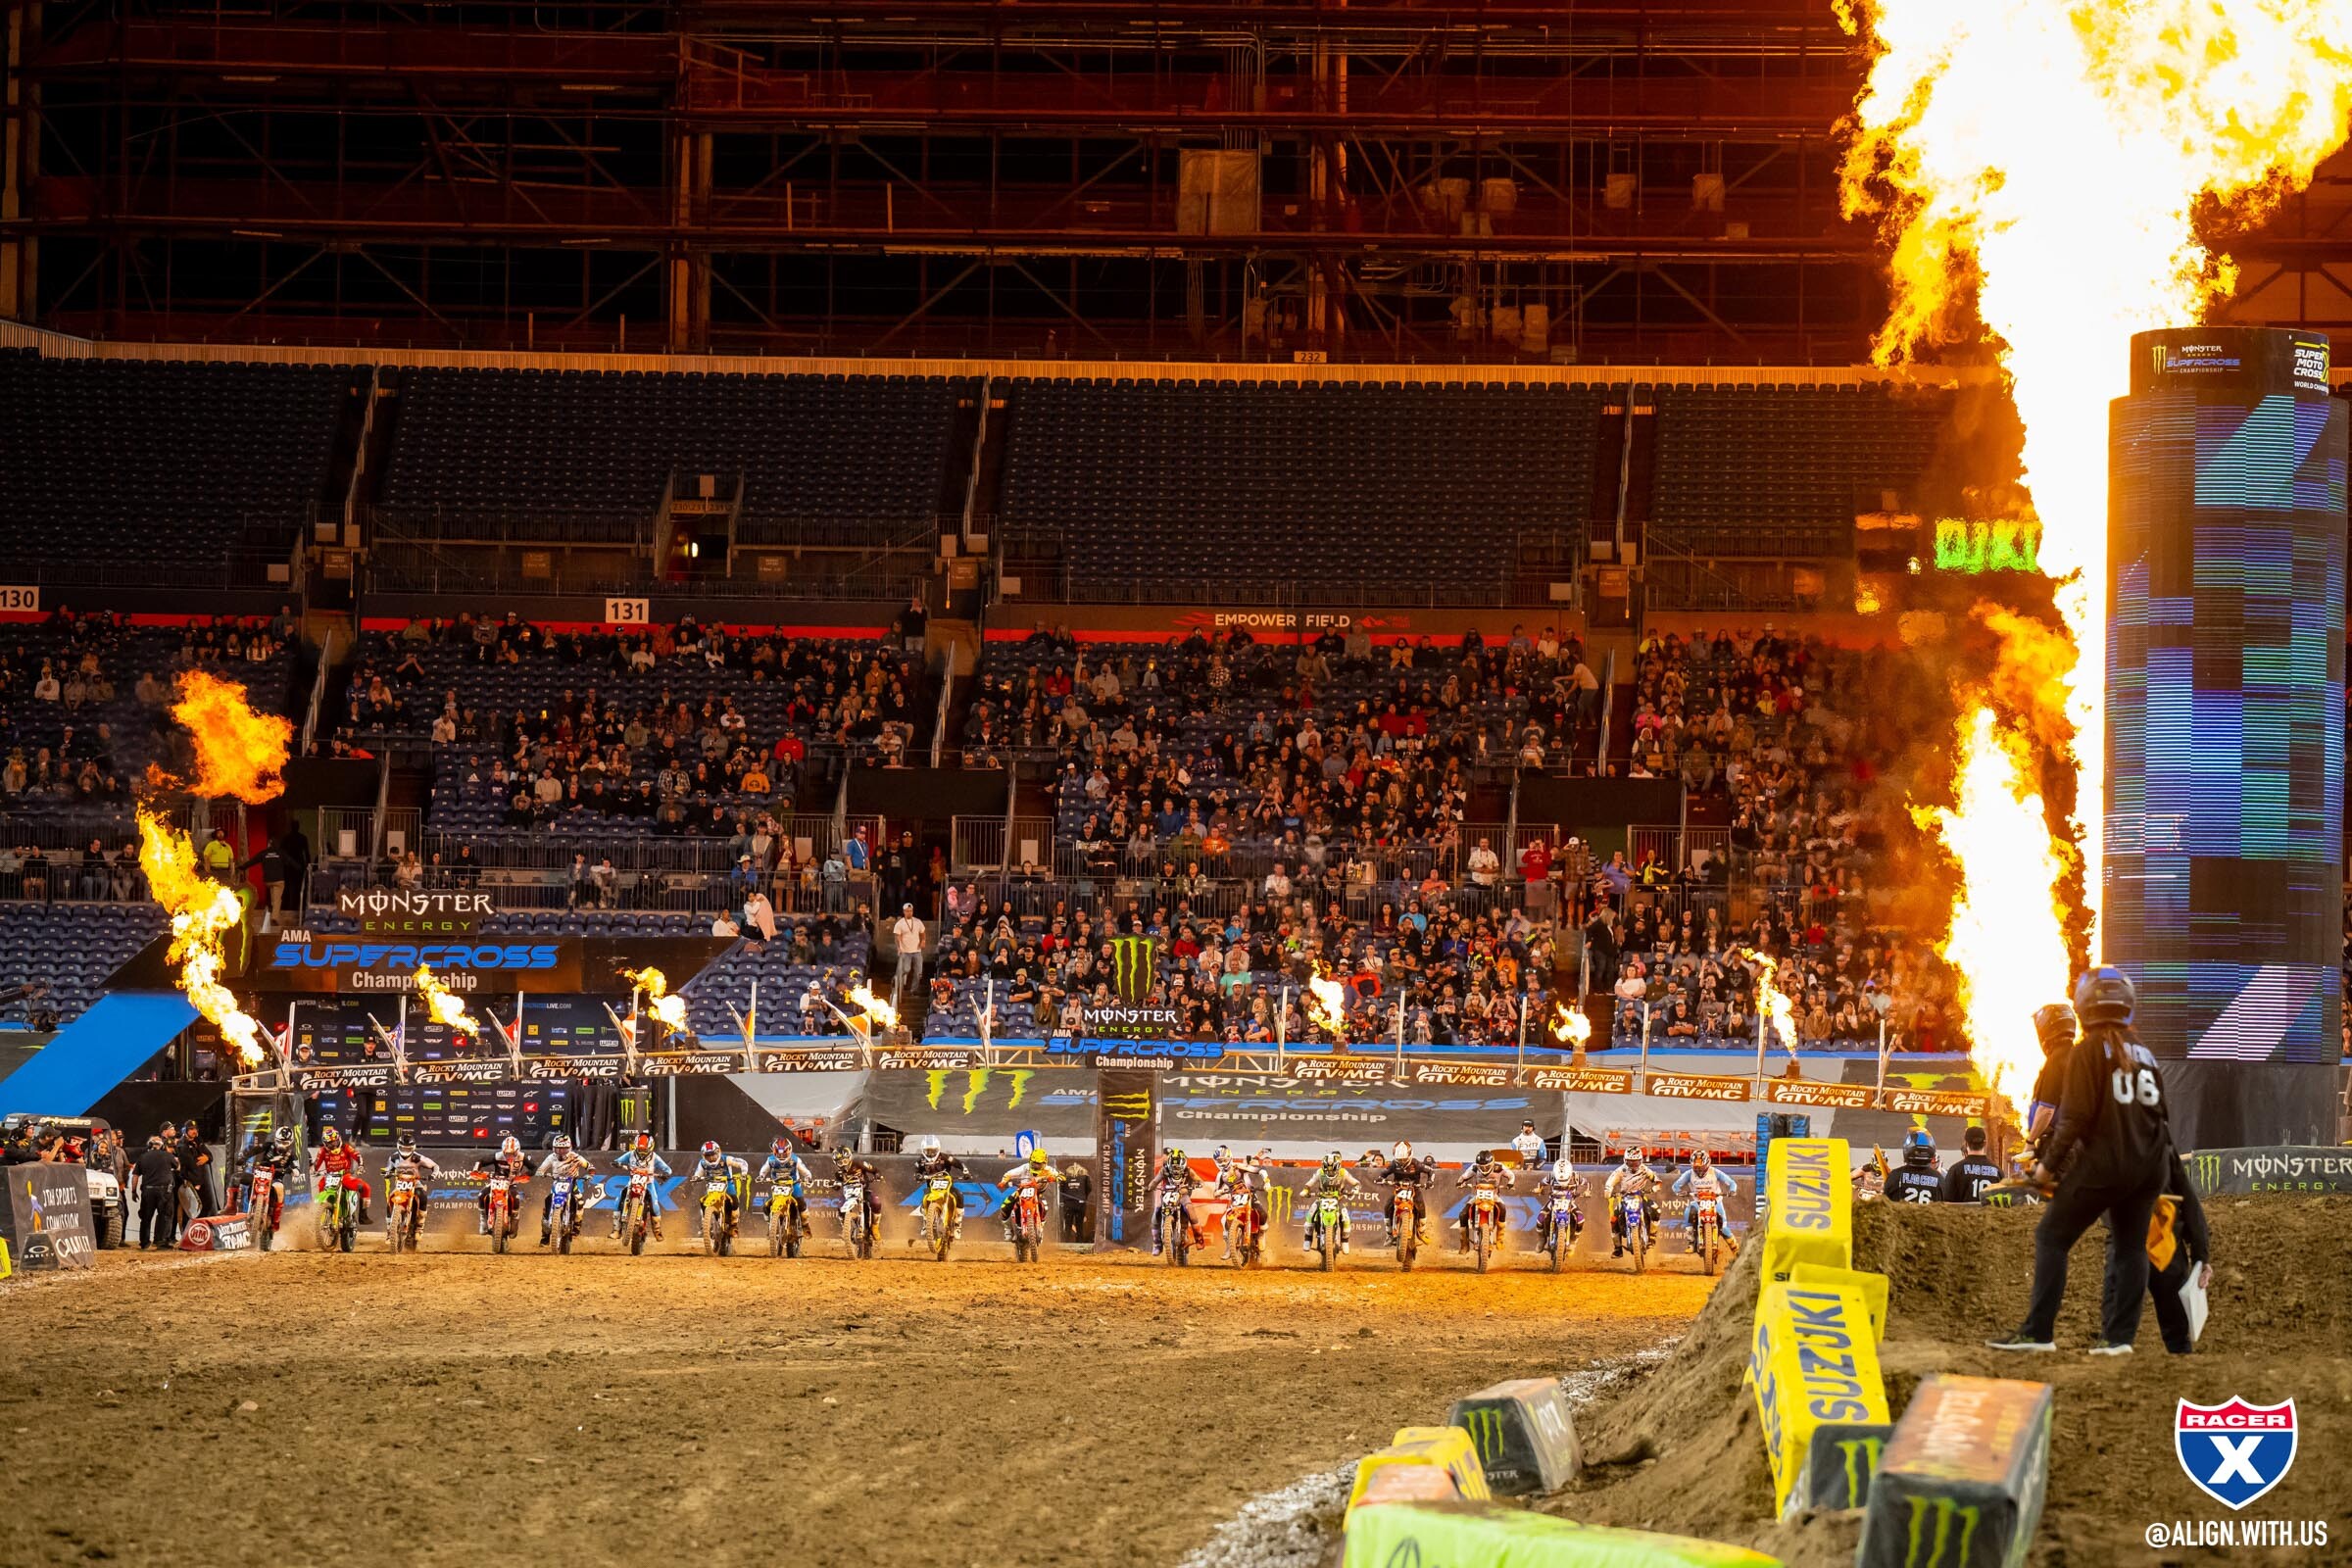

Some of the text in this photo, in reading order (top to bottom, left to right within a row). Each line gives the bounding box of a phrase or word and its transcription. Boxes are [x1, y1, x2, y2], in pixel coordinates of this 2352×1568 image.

[1300, 353, 1320, 362] 232
[2294, 349, 2324, 361] SUPER
[2166, 359, 2241, 368] SUPERCROSS
[2296, 358, 2323, 369] MOTO
[2293, 367, 2324, 379] CROSS
[2294, 380, 2314, 389] WORLD
[0, 590, 34, 608] 130
[612, 602, 643, 620] 131
[1215, 613, 1350, 628] EMPOWER FIELD
[341, 890, 494, 916] MONSTER
[366, 921, 471, 930] ENERGY
[281, 930, 312, 942] AMA
[271, 945, 559, 968] SUPERCROSS
[1084, 1007, 1178, 1024] MONSTER
[1045, 1038, 1224, 1057] SUPERCROSS
[428, 1062, 503, 1073] ROCKY MOUNTAIN
[1096, 1056, 1174, 1069] Championship
[1308, 1059, 1385, 1069] ROCKY MOUNTAIN
[1431, 1064, 1507, 1076] ROCKY MOUNTAIN
[1549, 1069, 1626, 1081] ROCKY MOUNTAIN
[1667, 1078, 1743, 1090] ROCKY MOUNTAIN
[1789, 1084, 1866, 1097] ROCKY MOUNTAIN
[1035, 1095, 1530, 1110] SPERCROSS
[1176, 1110, 1387, 1123] Championship
[2232, 1154, 2352, 1179] MONSTER
[632, 1174, 649, 1185] 84
[1112, 1120, 1125, 1241] SUPERCROSS
[1134, 1148, 1147, 1213] MONSTER
[844, 1187, 860, 1198] 24
[1786, 1144, 1832, 1230] SUZUKI
[2252, 1182, 2337, 1192] ENERGY
[55, 1186, 77, 1206] SPORTS
[1162, 1192, 1179, 1202] 43
[1232, 1194, 1249, 1205] 34
[1396, 1190, 1412, 1200] 41
[1904, 1188, 1932, 1204] 26
[1320, 1199, 1338, 1209] 52
[1786, 1289, 1870, 1423] SUZUKI
[1488, 1469, 1519, 1481] STER
